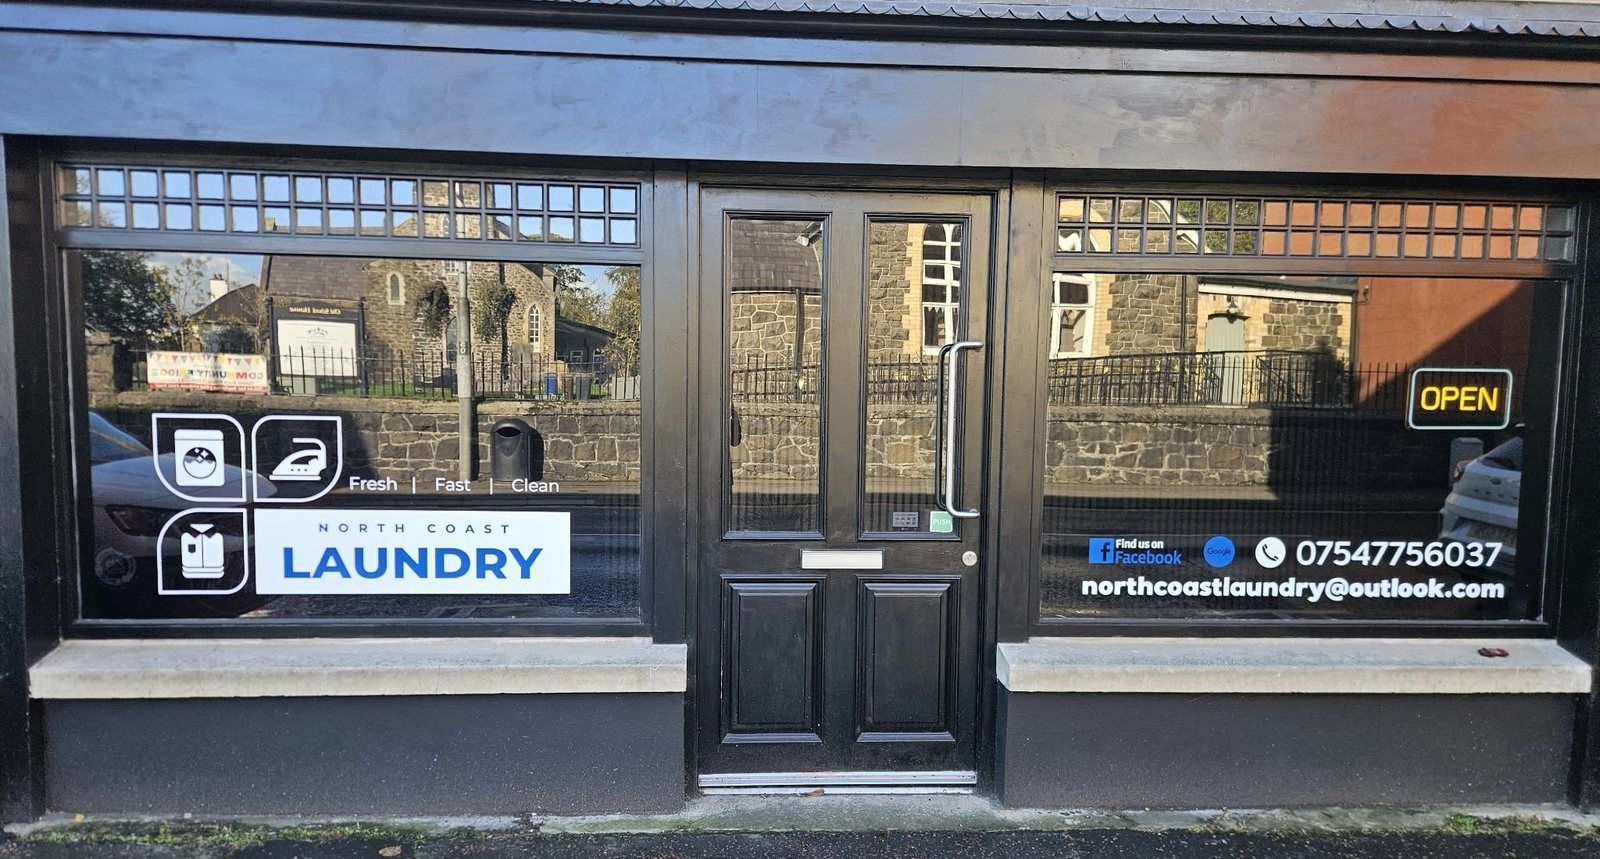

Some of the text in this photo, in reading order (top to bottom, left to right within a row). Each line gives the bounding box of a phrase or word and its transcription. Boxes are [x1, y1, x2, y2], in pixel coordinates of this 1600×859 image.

[1420, 386, 1499, 412] OPEN
[349, 476, 560, 493] Fresh Fast Clean
[319, 523, 510, 534] NORTH COAST
[932, 518, 951, 526] PUSH
[1115, 538, 1165, 549] Find us on
[1207, 547, 1232, 556] Google
[1114, 550, 1183, 565] Facebook
[1296, 540, 1503, 567] 07547756037
[283, 547, 543, 580] LAUNDRY
[1081, 576, 1505, 603] northcoastlaundry@outlook.com
